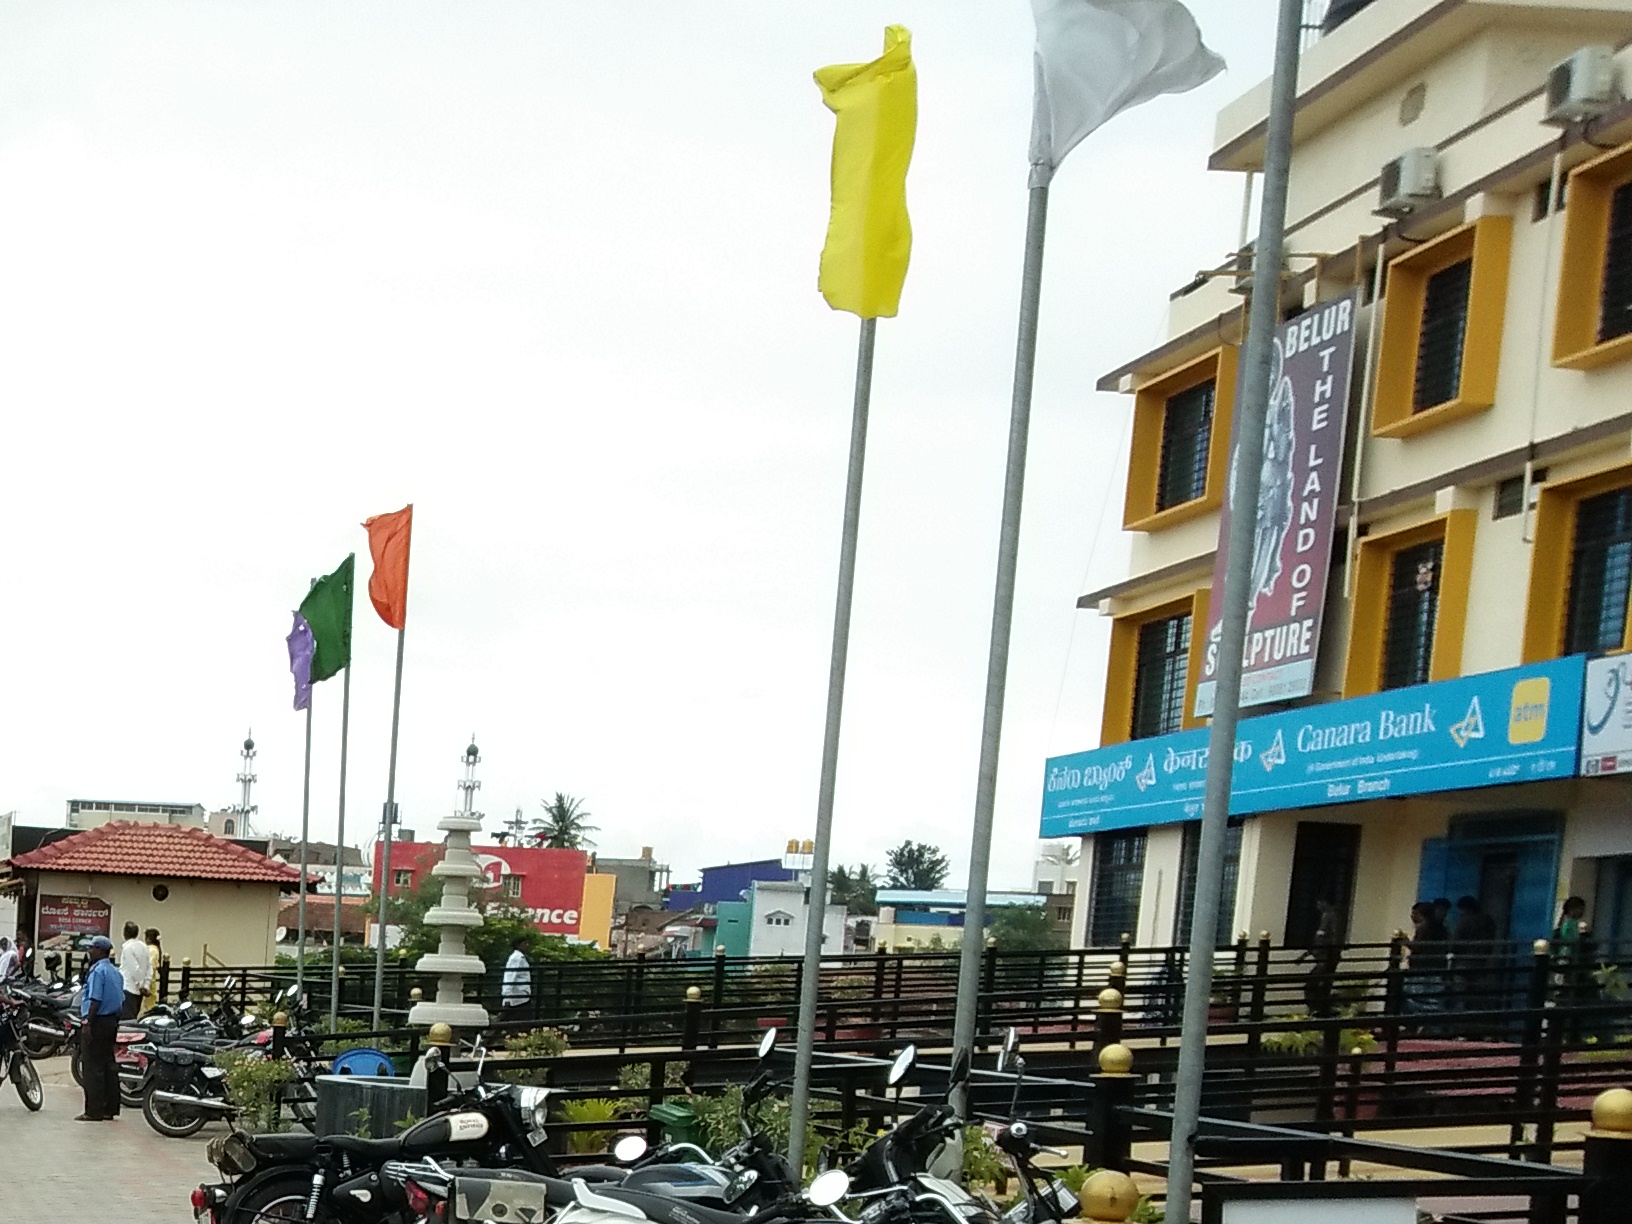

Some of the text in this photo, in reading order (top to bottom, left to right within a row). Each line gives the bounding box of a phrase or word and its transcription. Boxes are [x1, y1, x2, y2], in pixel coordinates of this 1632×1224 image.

[1285, 299, 1351, 359] BELUR
[1290, 347, 1335, 617] THE LAND OF
[1205, 619, 1314, 676] SLPTURE
[1297, 704, 1436, 753] Canara Bank
